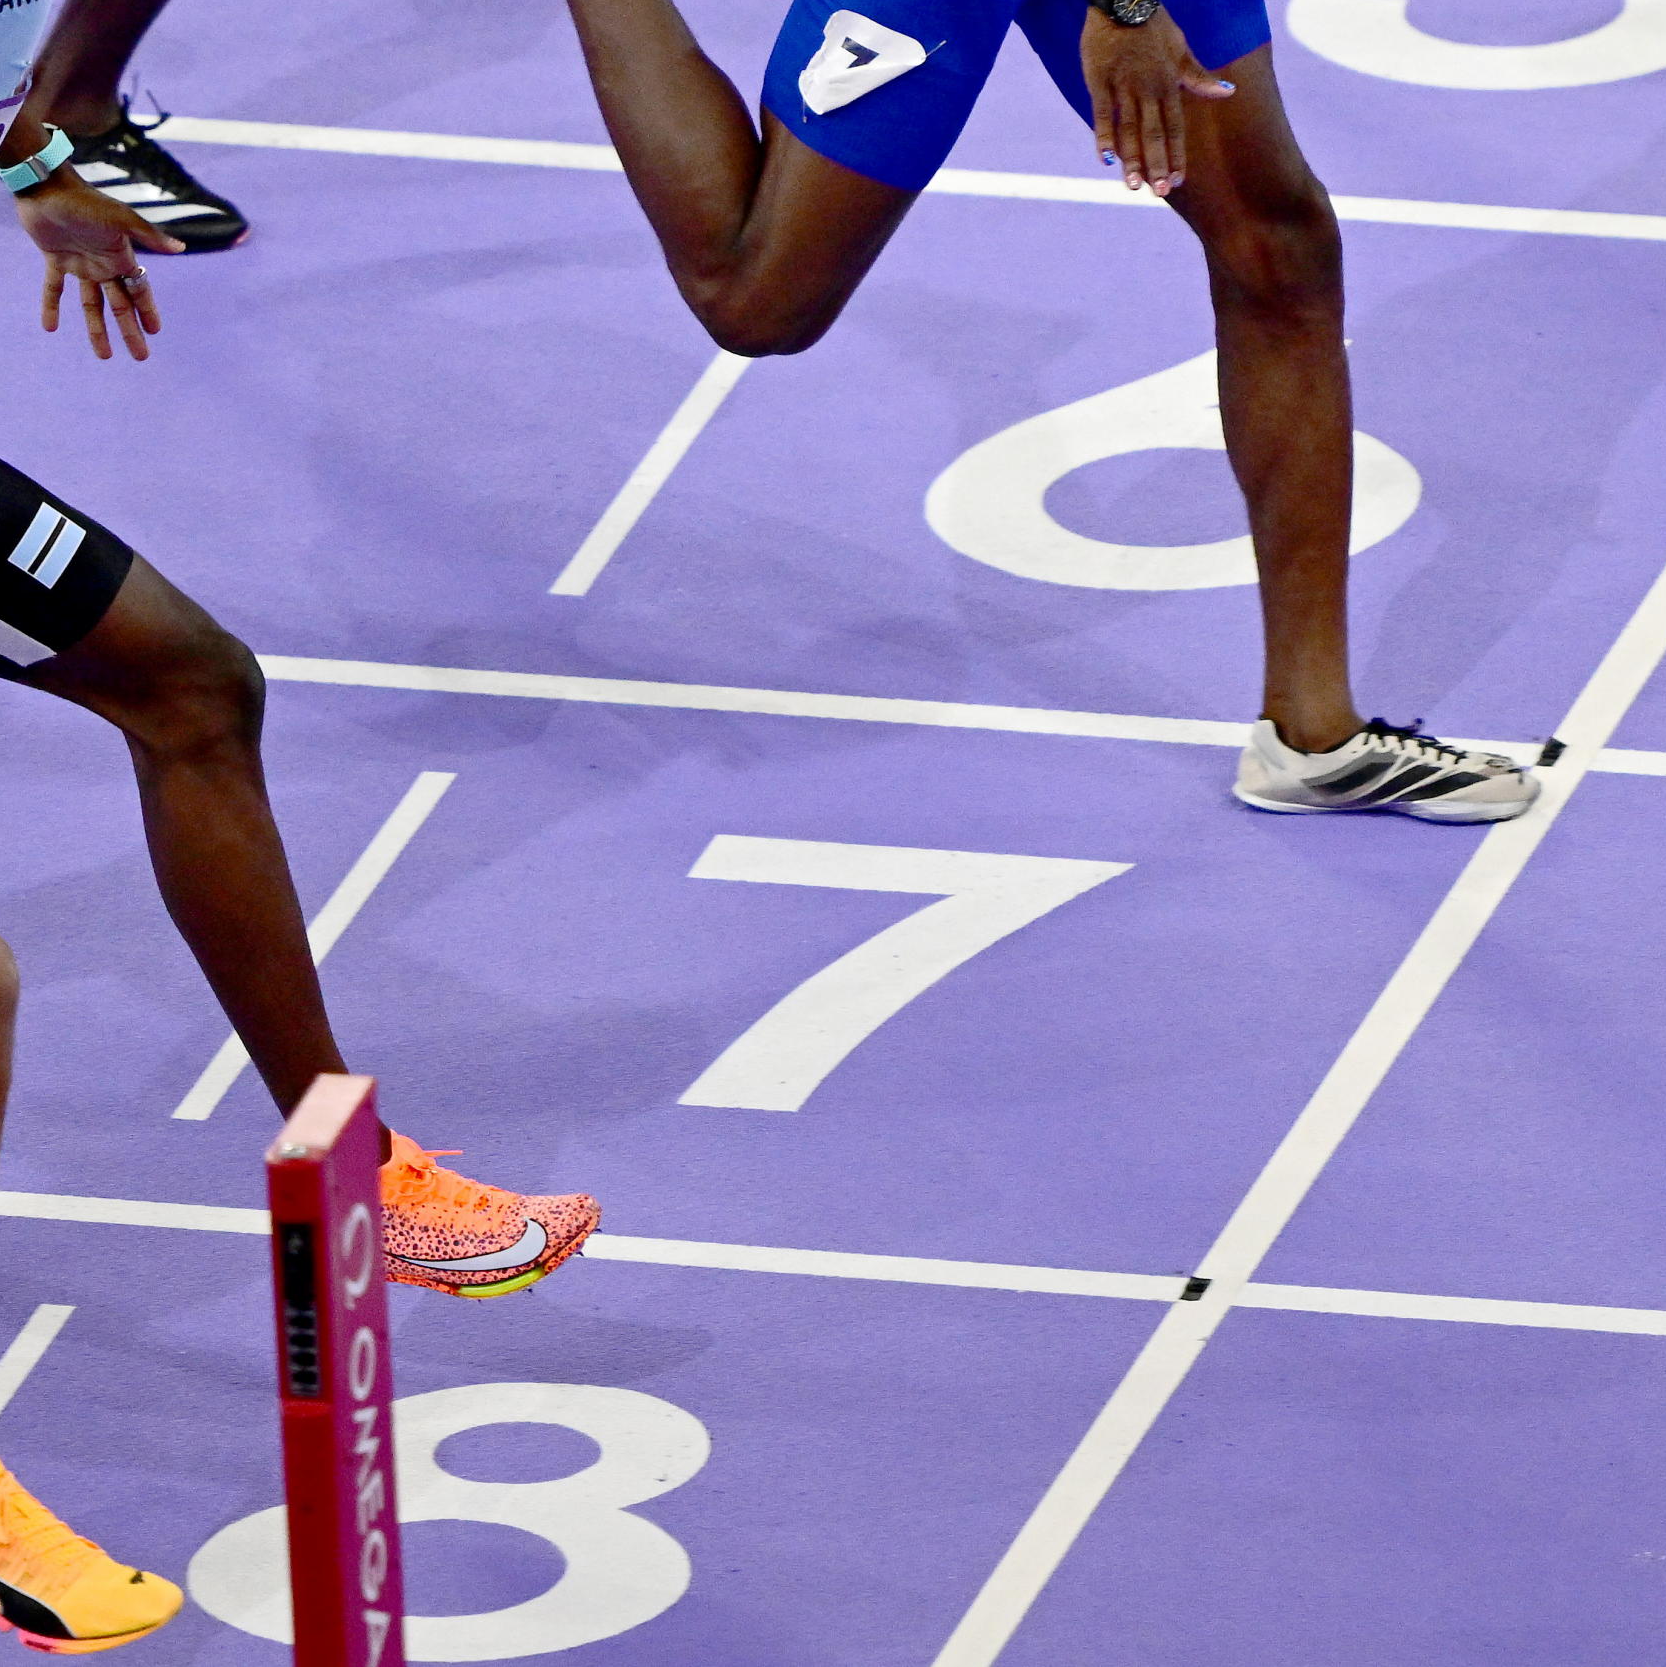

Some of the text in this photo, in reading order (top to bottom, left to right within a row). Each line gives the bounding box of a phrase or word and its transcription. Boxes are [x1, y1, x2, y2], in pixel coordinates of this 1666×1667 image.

[924, 338, 1423, 592] 6
[676, 834, 1137, 1113] 7
[186, 1381, 712, 1663] 8
